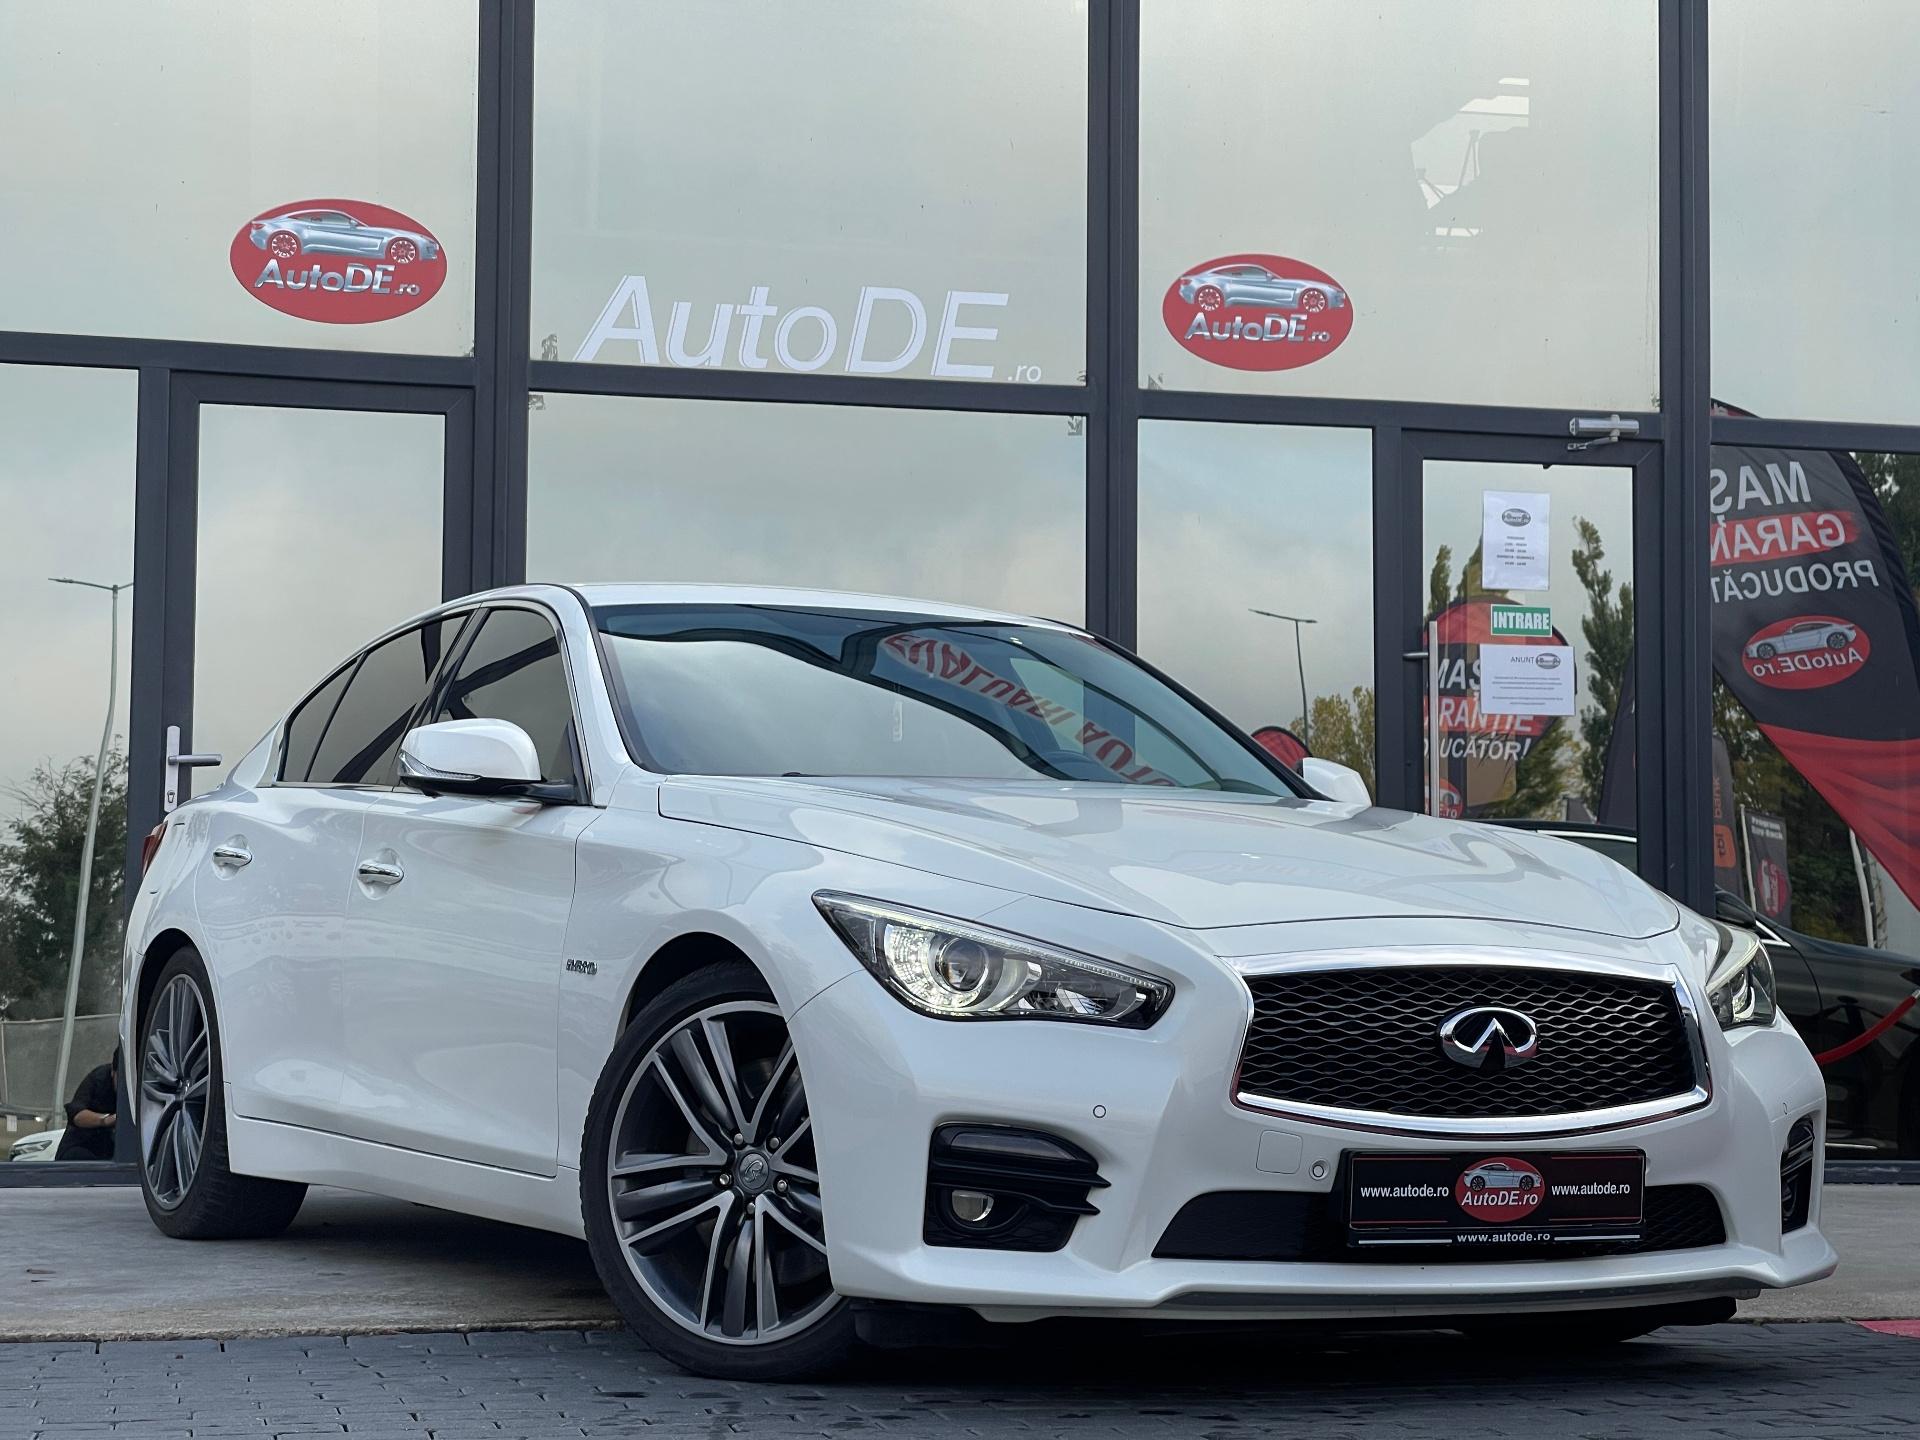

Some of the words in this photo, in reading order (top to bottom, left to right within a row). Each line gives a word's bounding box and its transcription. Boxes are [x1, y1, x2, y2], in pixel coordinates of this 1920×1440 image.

[254, 258, 421, 297] AutoDE.ro
[1184, 311, 1331, 343] AutoDE.ro
[1493, 611, 1550, 631] INTRARE
[1361, 1184, 1450, 1198] www.autode.ro
[1461, 1190, 1539, 1207] AutoDE.ro
[1551, 1183, 1631, 1197] www.autode.ro
[1457, 1231, 1550, 1244] www.autode.ro
